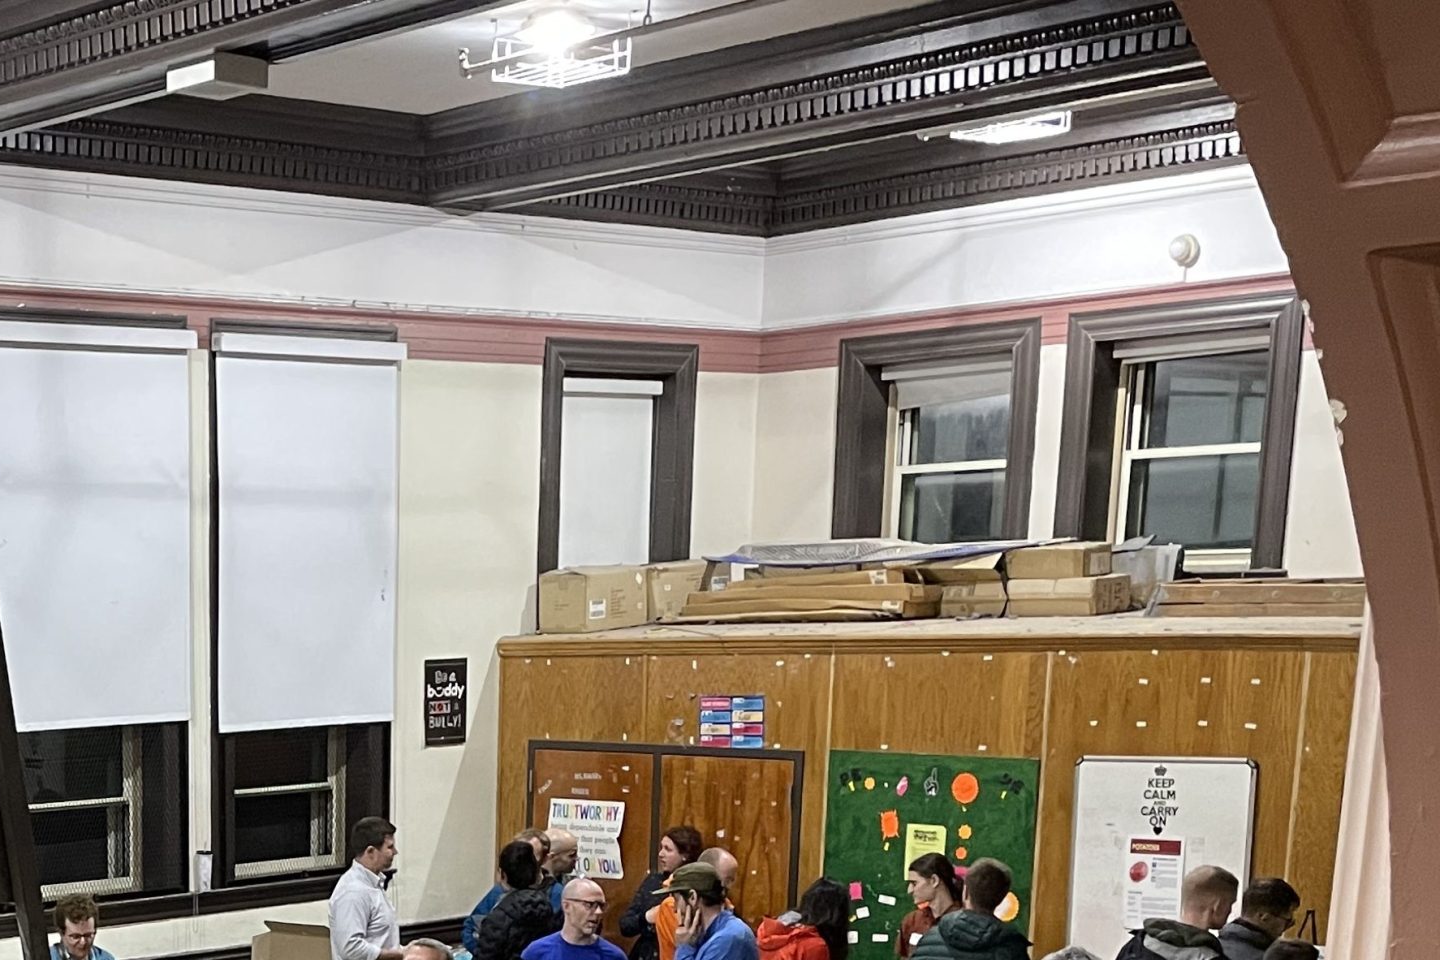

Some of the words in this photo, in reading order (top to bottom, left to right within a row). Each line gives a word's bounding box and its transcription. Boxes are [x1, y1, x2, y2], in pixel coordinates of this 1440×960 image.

[427, 683, 465, 699] buddy
[429, 701, 451, 714] NOT
[1147, 778, 1175, 788] KEEP
[1143, 789, 1176, 801] CALM
[1140, 806, 1179, 817] CARRY
[1149, 816, 1167, 827] ON
